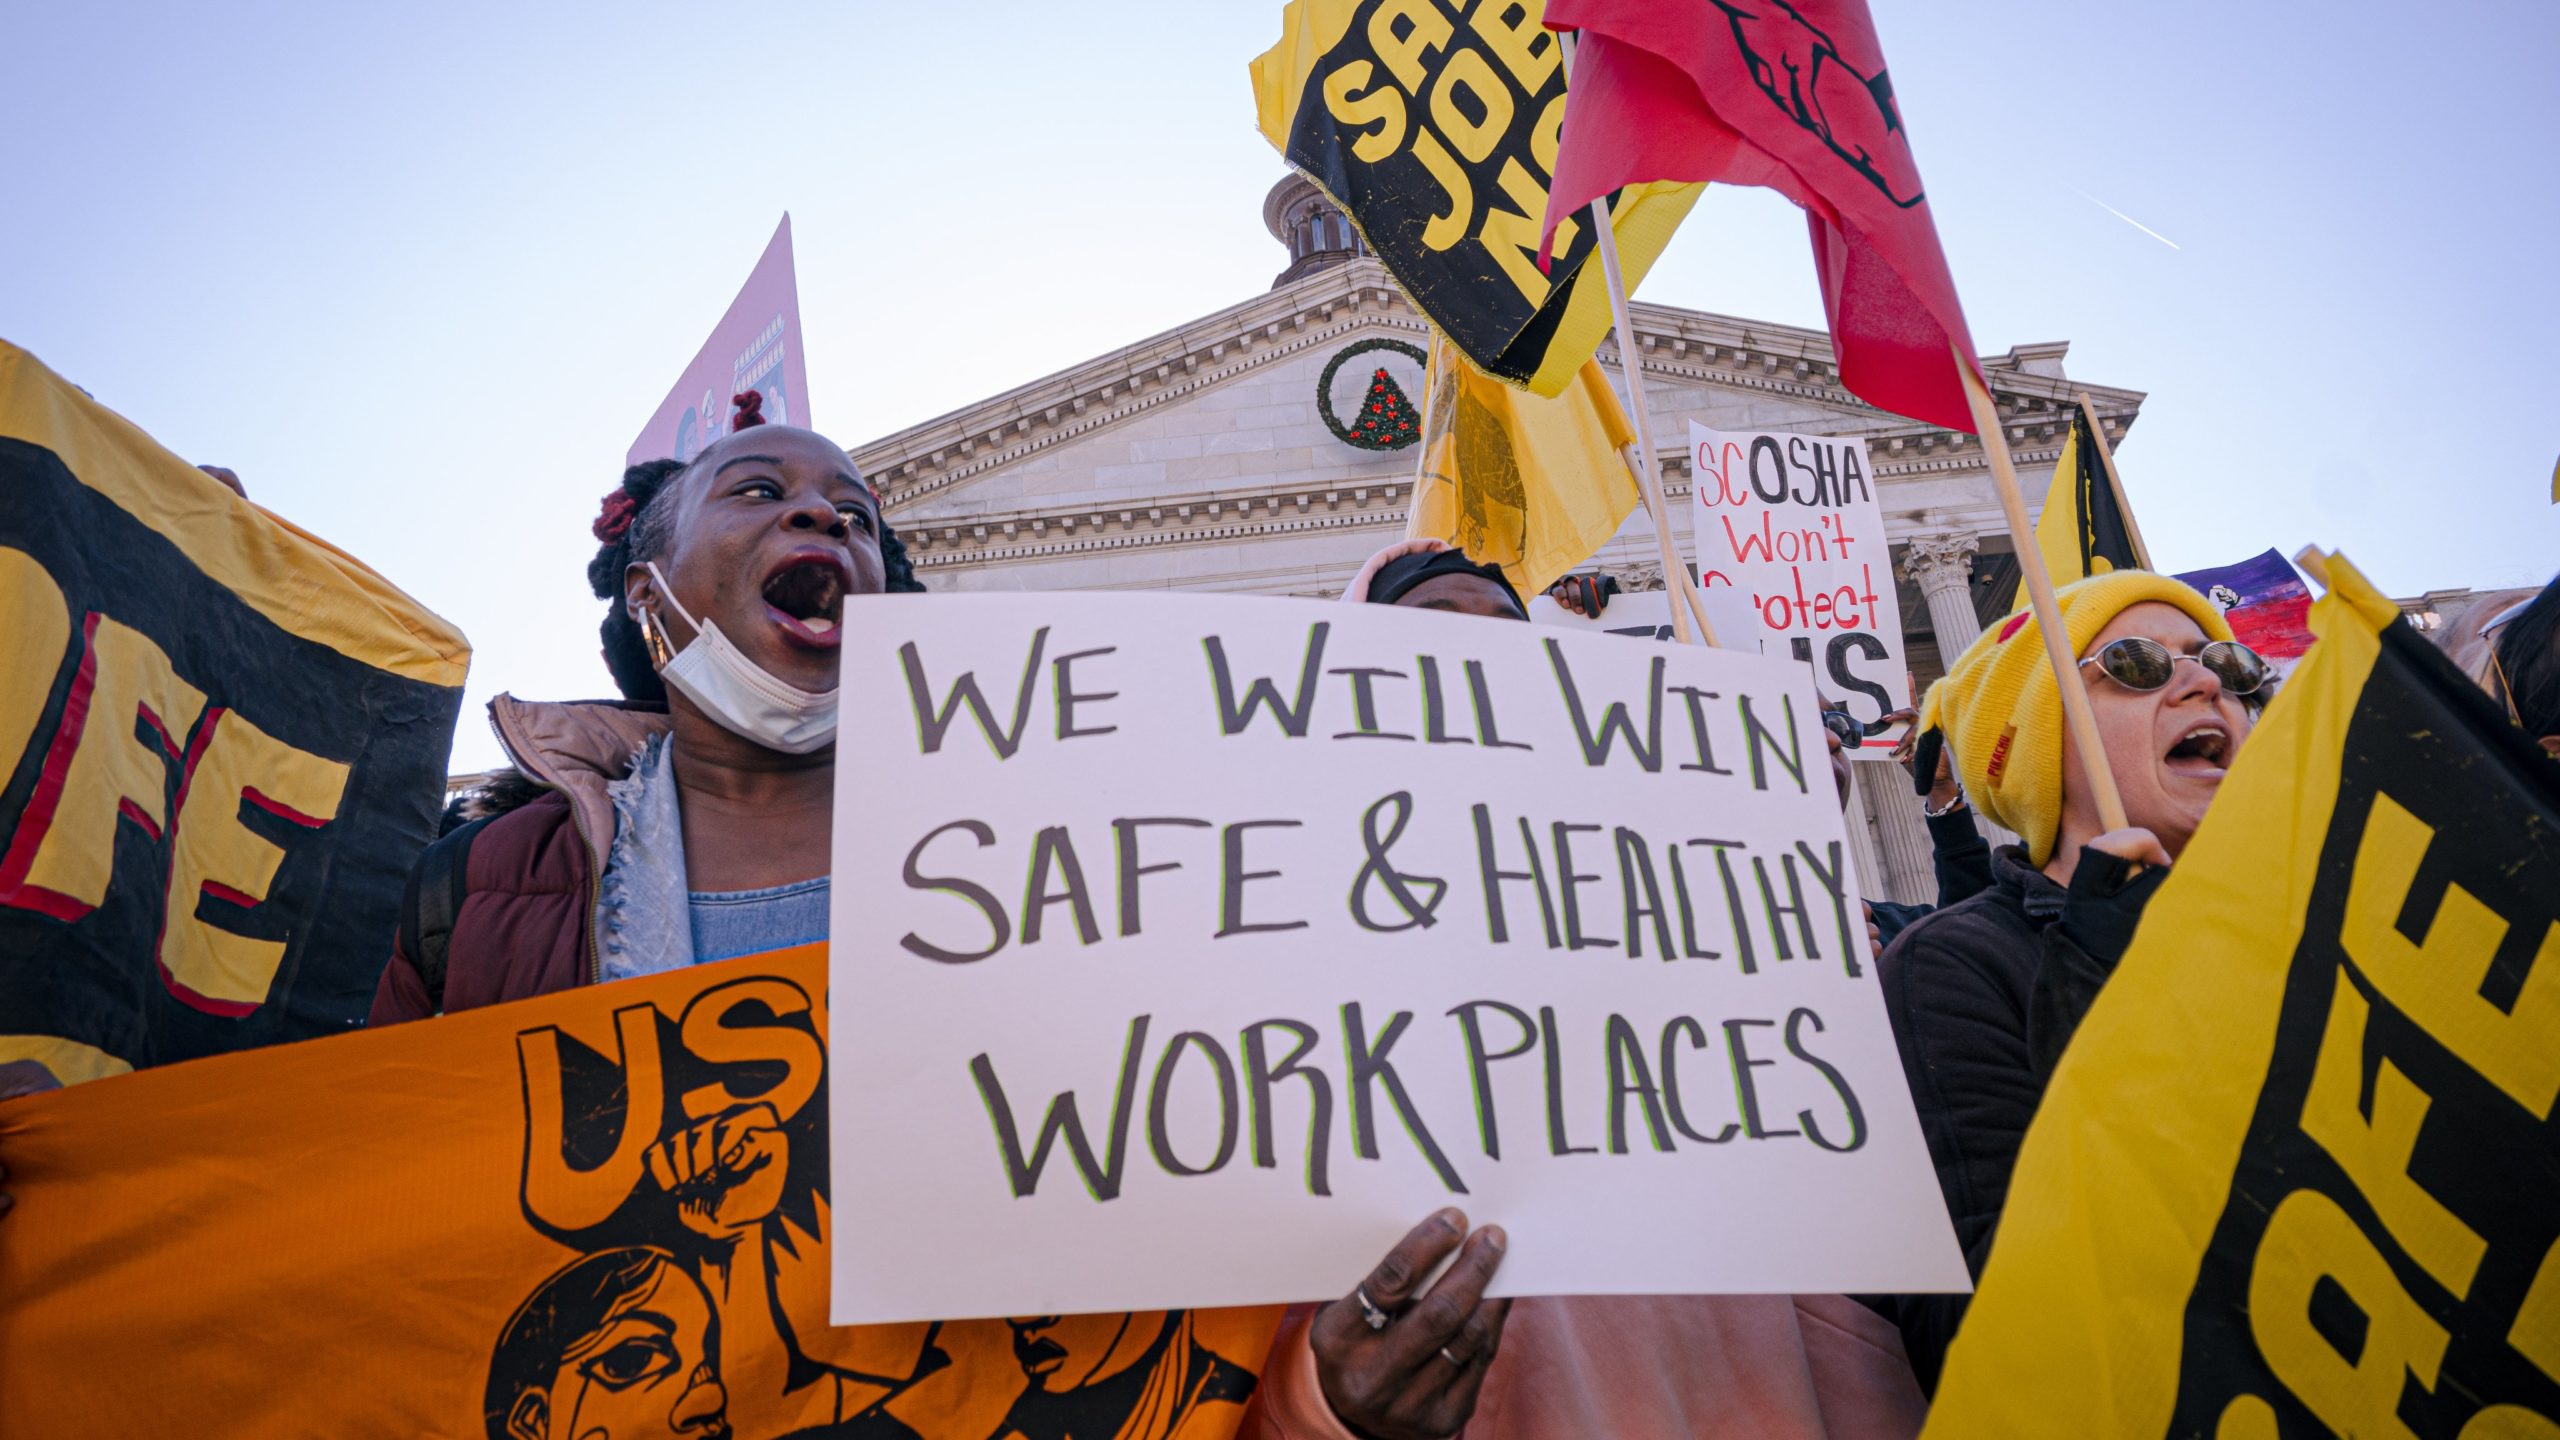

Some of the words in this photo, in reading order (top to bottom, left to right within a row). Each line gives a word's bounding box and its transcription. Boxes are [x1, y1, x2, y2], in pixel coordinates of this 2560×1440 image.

[1322, 0, 1467, 163] SA
[1703, 563, 1879, 631] otect
[1721, 510, 1855, 563] Won't
[898, 625, 1118, 762] WE
[1200, 620, 1533, 752] WILL
[1541, 636, 1809, 796] WIN
[1760, 632, 1894, 737] S
[1986, 734, 2010, 777] PIKACHU
[898, 817, 1311, 966] SAFE
[1347, 790, 1448, 934] &
[1471, 802, 1863, 979] HEALTHY
[2214, 789, 2560, 1440] AFE
